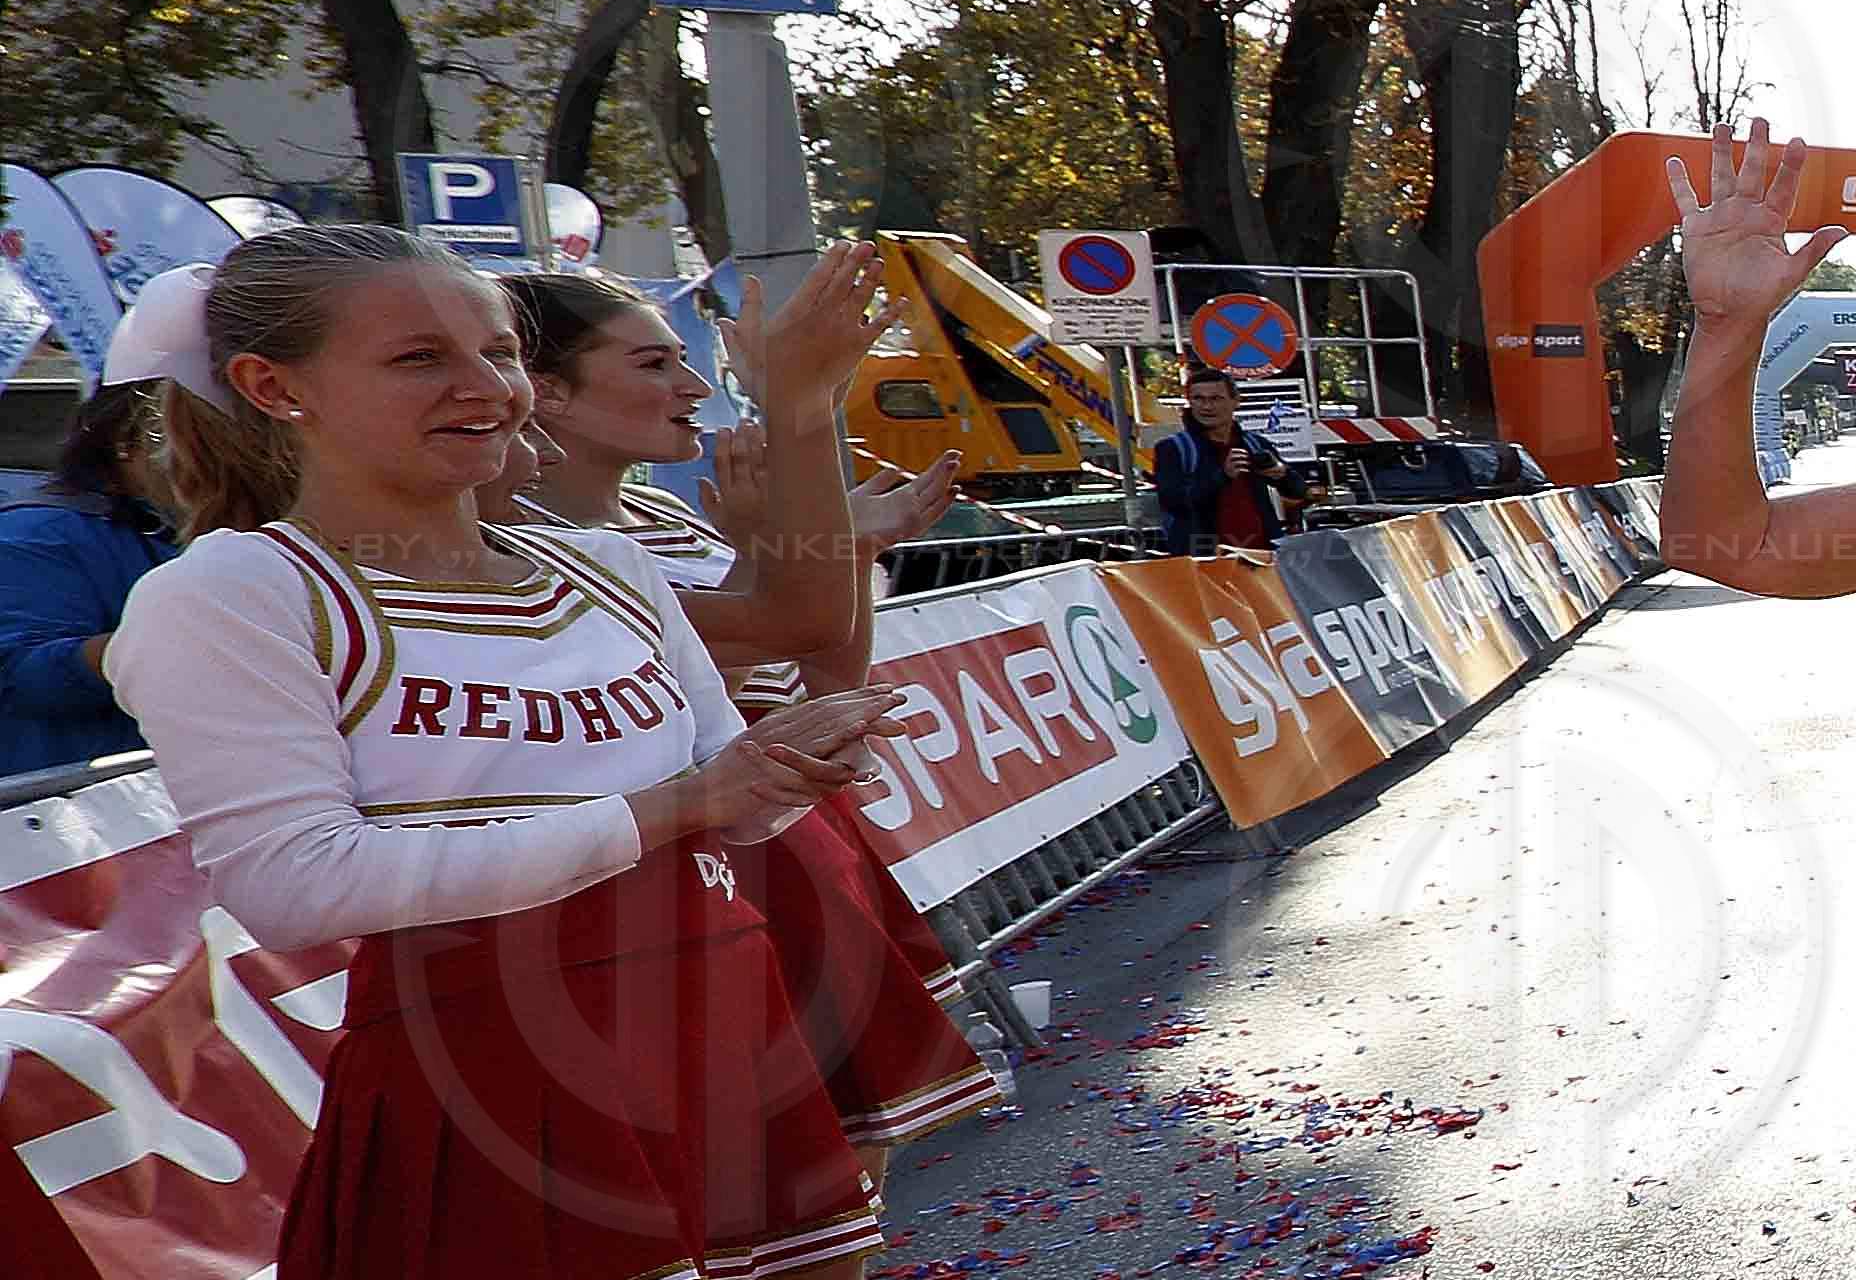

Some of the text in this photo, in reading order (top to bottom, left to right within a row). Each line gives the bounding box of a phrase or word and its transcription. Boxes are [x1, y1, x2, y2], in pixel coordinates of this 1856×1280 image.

[429, 162, 496, 221] P
[1533, 333, 1583, 348] sport
[390, 655, 686, 745] REDHOT
